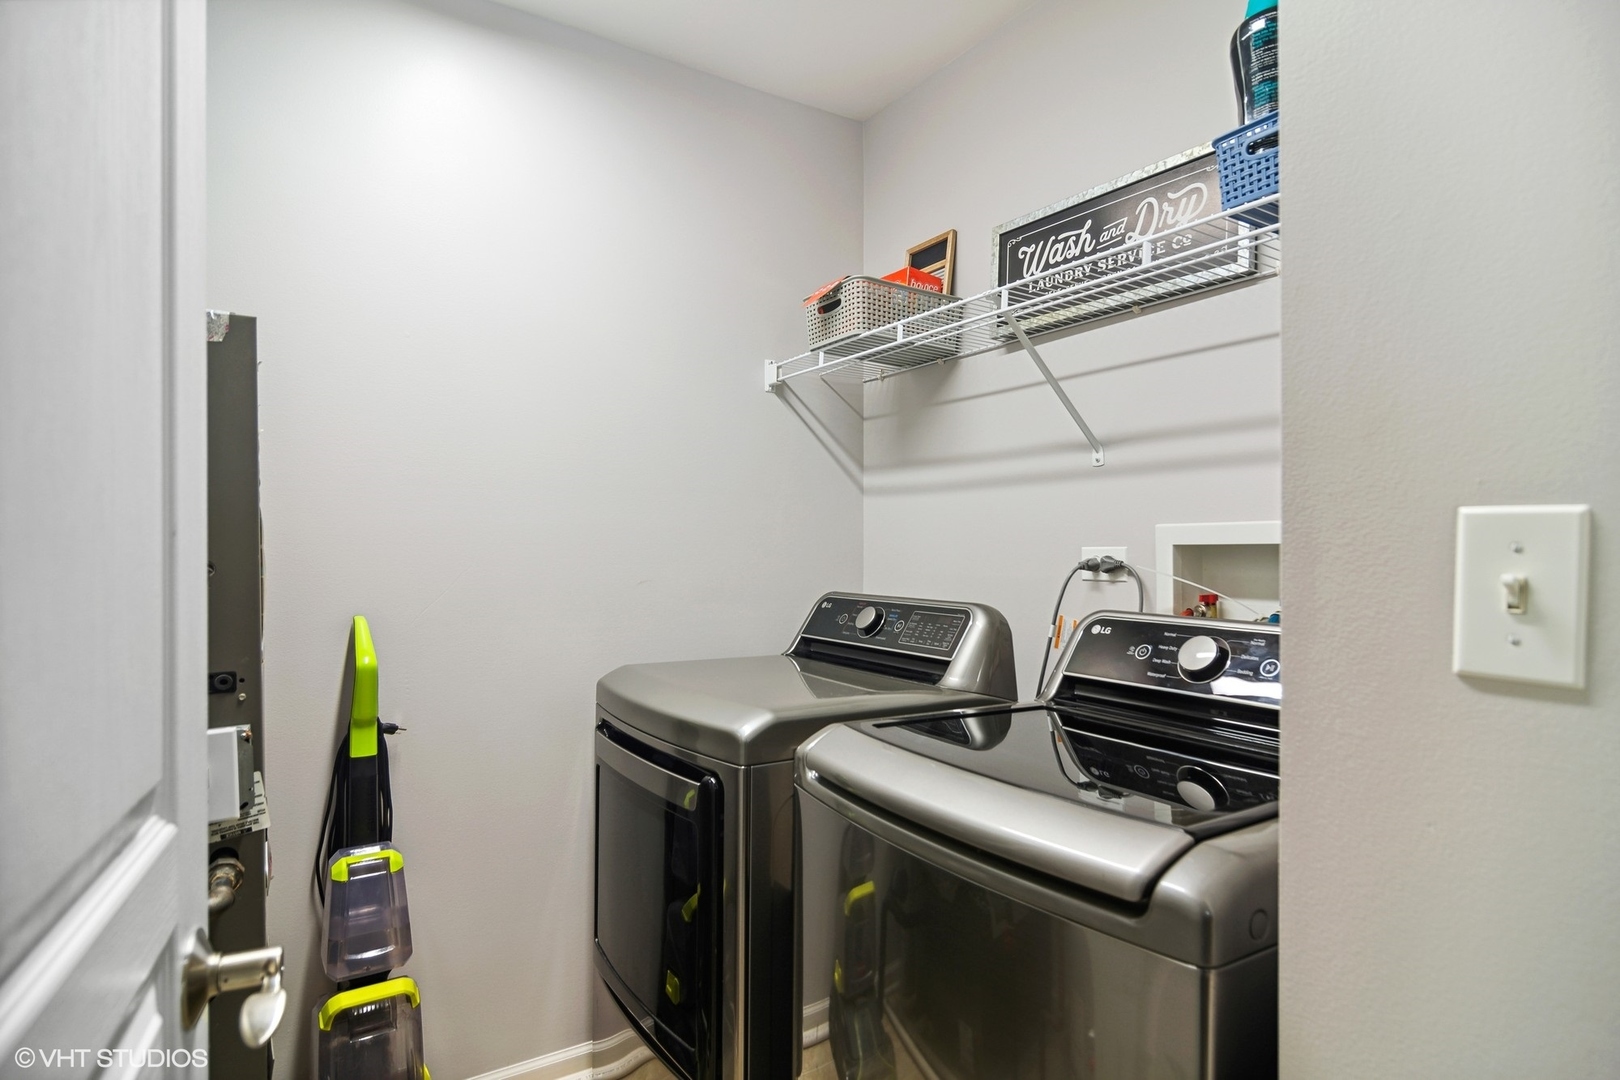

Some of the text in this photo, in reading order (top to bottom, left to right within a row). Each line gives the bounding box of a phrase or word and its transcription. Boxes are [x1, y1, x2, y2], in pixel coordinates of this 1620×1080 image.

[1018, 218, 1096, 278] Wash
[1099, 217, 1128, 243] and
[1125, 182, 1208, 244] Dry
[1028, 262, 1095, 293] LAUNDRY
